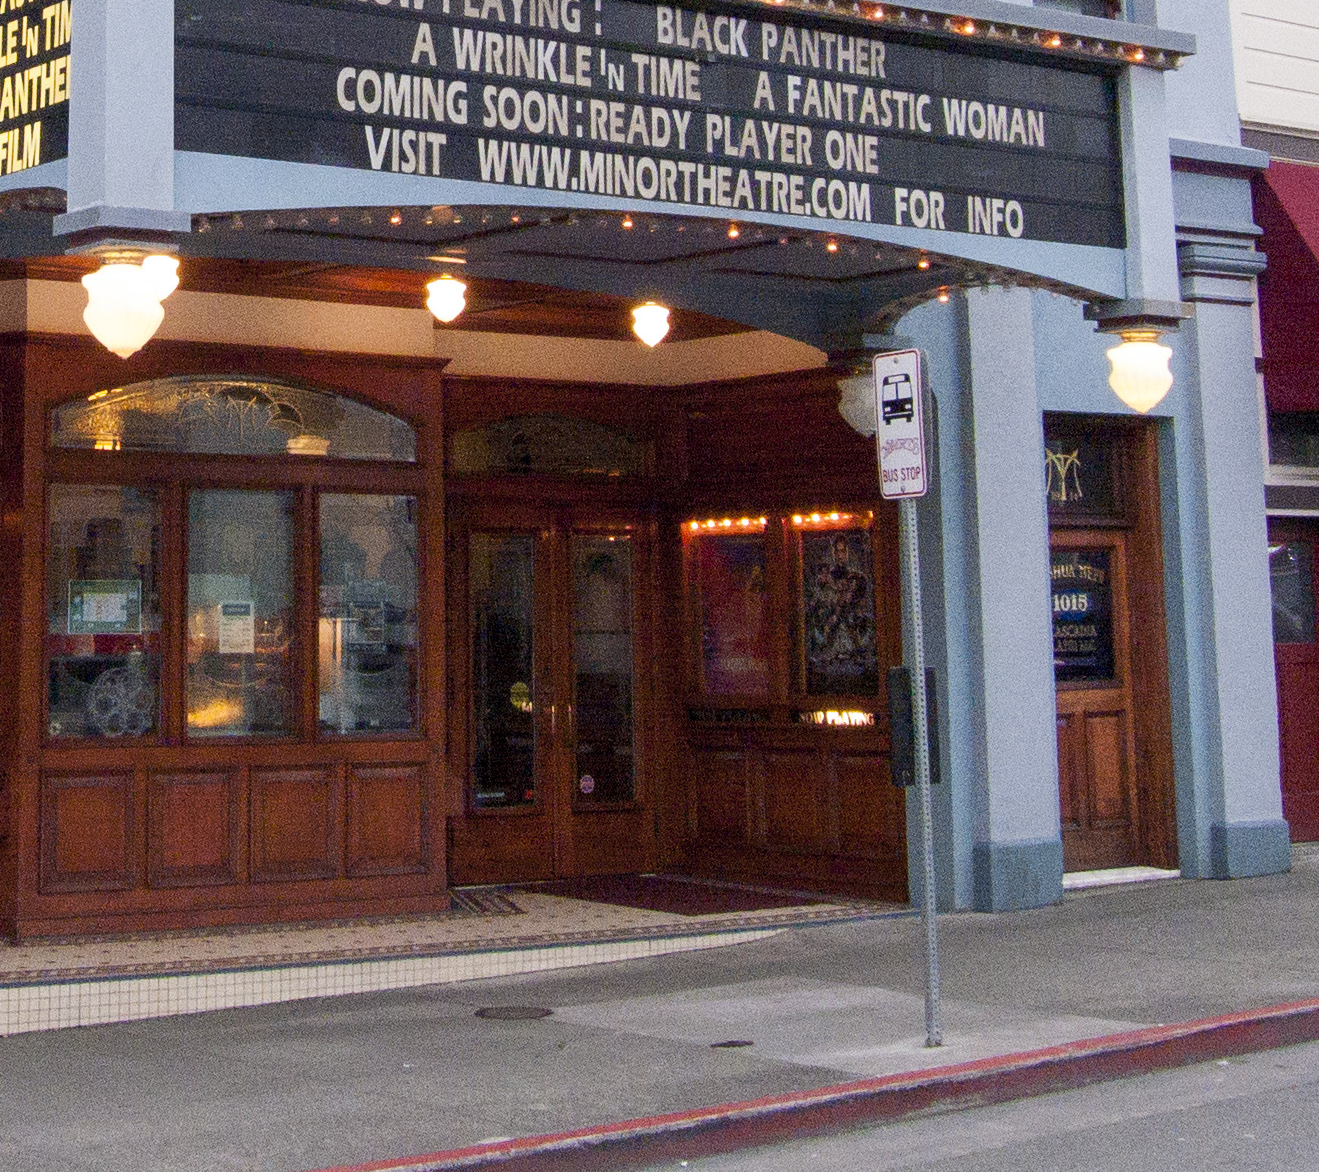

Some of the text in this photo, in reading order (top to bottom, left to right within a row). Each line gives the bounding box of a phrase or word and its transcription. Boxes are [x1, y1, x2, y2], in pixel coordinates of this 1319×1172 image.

[42, 0, 72, 52] TIM
[656, 6, 749, 58] BLACK
[761, 22, 886, 78] PANTHER
[336, 66, 468, 125] COMING
[706, 113, 813, 166] PLAYER
[825, 130, 879, 174] ONE
[410, 22, 437, 66] A
[452, 27, 592, 87] WRINKLE
[631, 53, 702, 101] TIME
[753, 71, 775, 111] A
[787, 74, 932, 133] FANTASTIC
[942, 97, 1045, 148] WOMAN
[364, 125, 1024, 238] VISIT WWW.MINORTHEATRE.COM FOR INFO
[883, 465, 921, 483] BUS STOP
[1053, 593, 1088, 612] 1015
